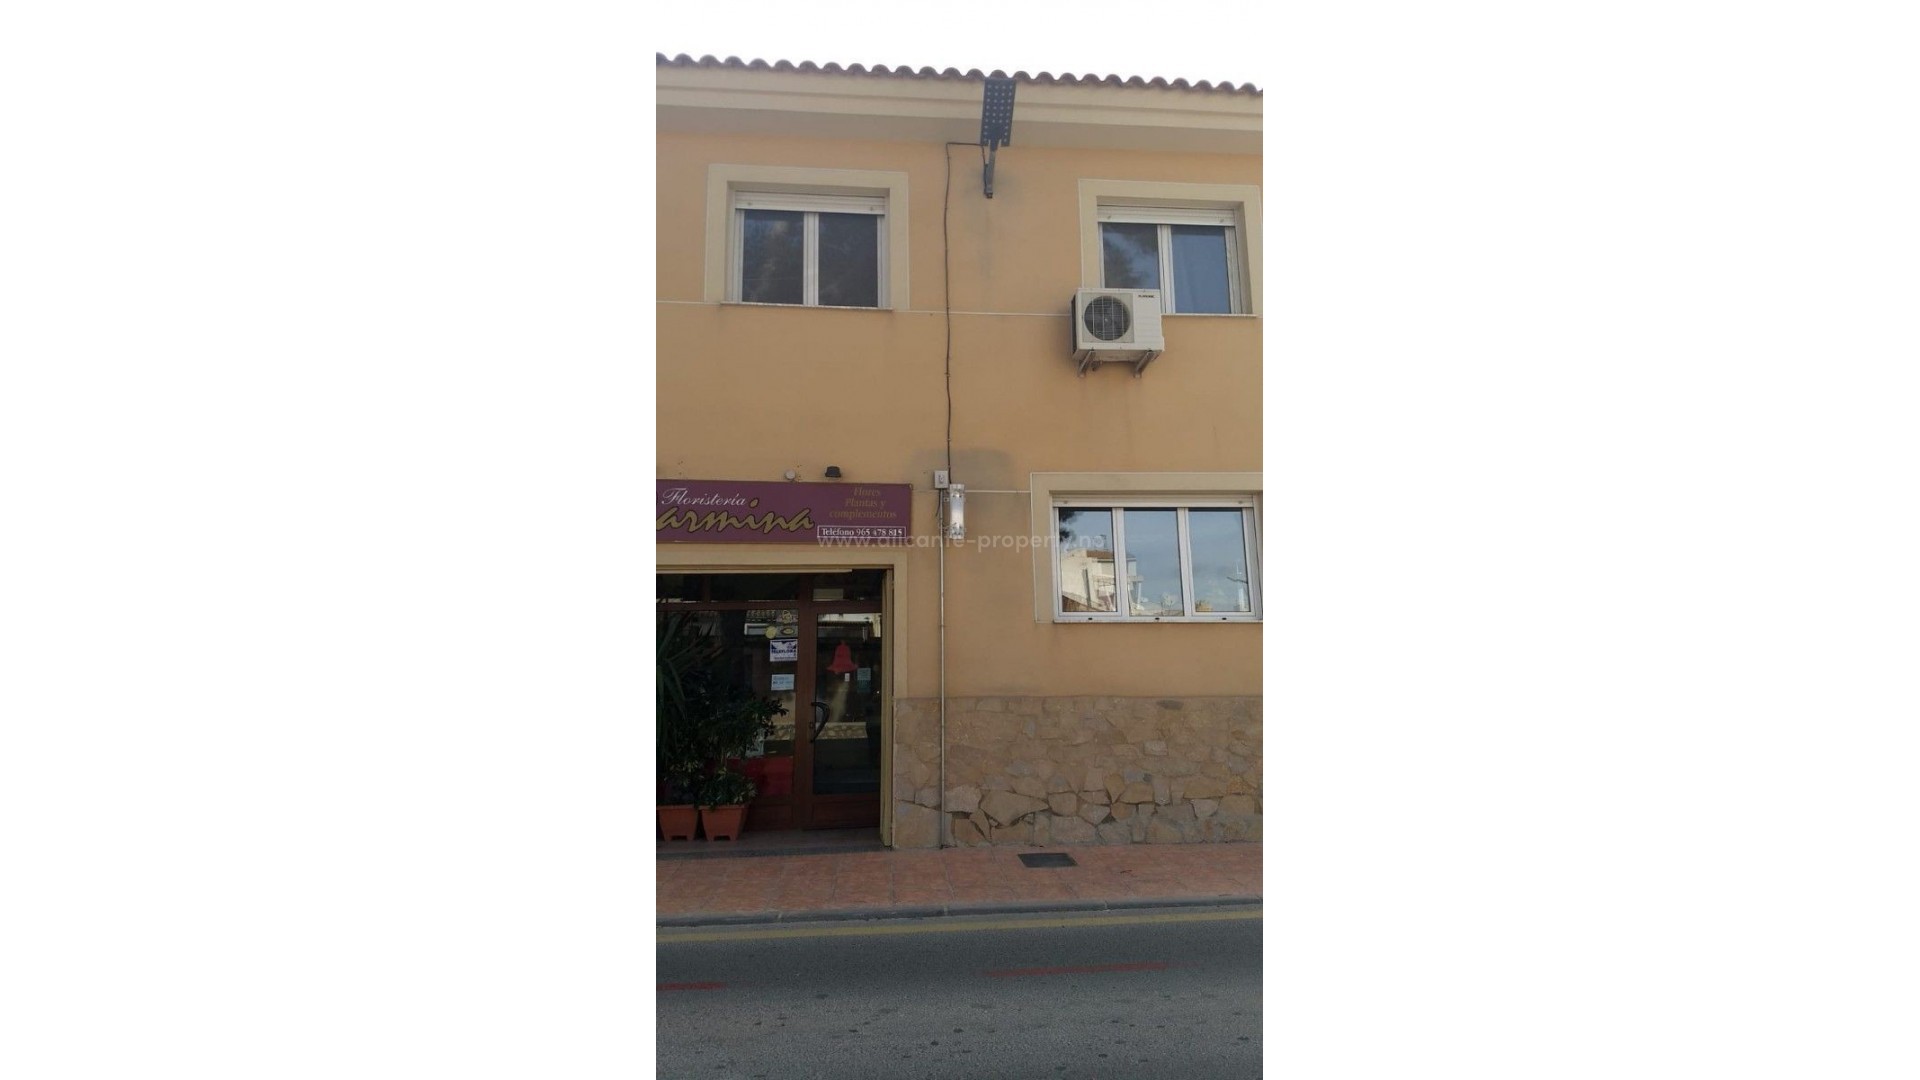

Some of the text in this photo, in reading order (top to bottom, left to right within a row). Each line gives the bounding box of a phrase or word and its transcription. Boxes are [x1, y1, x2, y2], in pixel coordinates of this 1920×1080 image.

[661, 487, 746, 505] Floristería
[853, 487, 881, 497] Flores
[845, 498, 887, 509] Plantas y
[656, 497, 815, 534] armina
[829, 509, 897, 520] complementos
[822, 528, 854, 536] Teléfono
[856, 528, 870, 536] 965
[873, 528, 886, 536] 478
